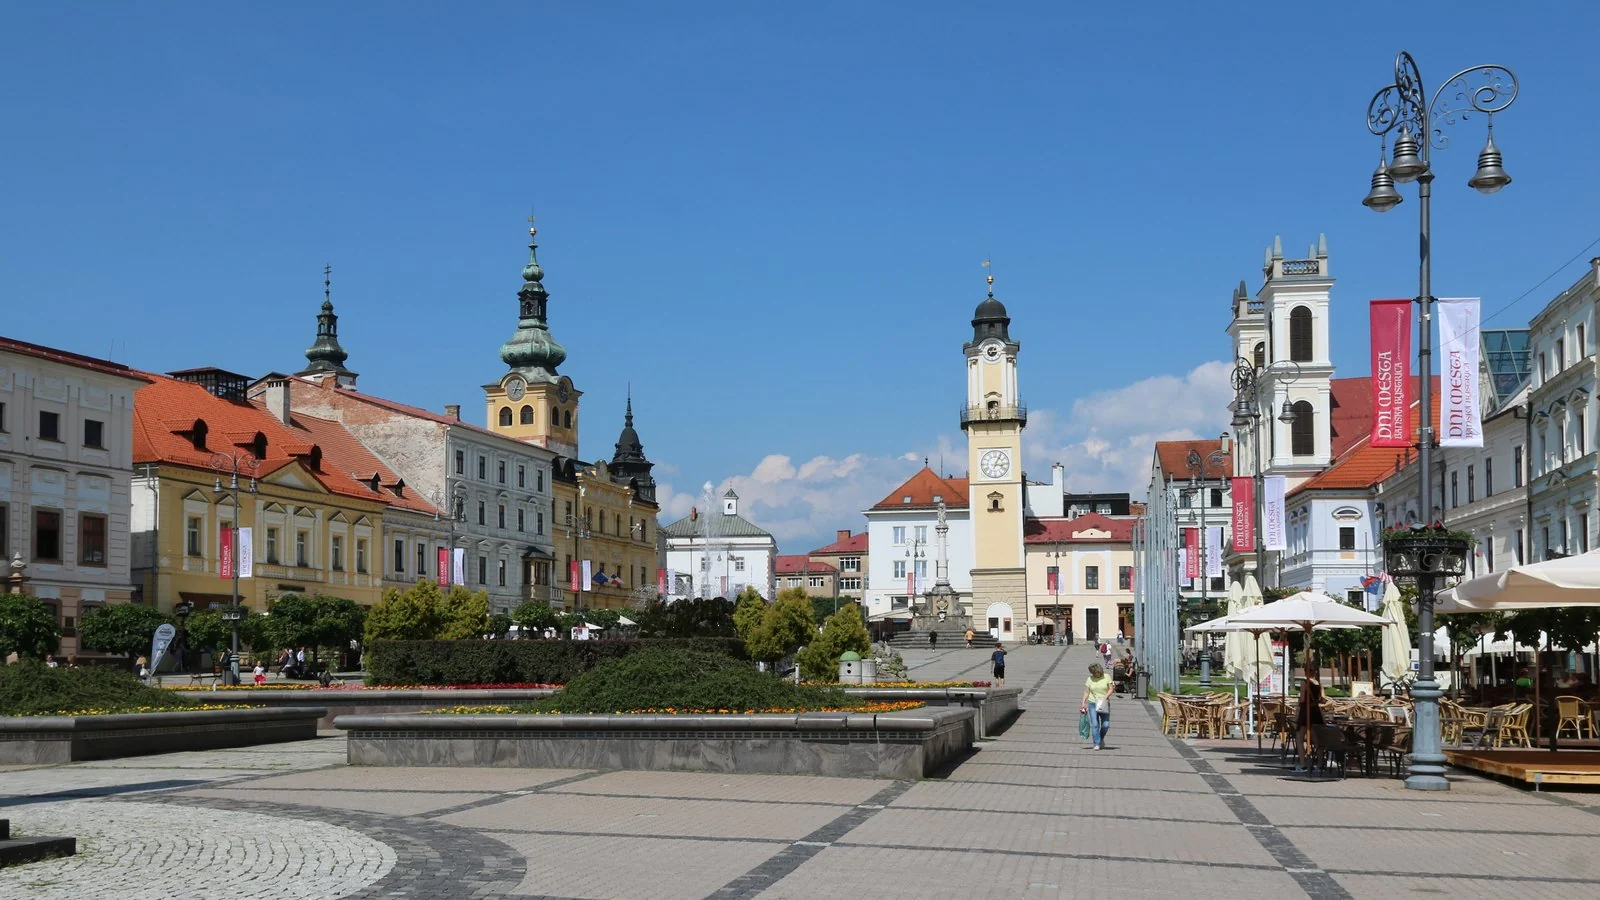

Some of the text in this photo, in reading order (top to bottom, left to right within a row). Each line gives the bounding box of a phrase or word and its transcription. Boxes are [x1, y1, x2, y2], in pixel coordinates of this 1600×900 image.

[1378, 350, 1392, 439] DNI MESTA
[1394, 362, 1404, 405] BYSTRICA
[1449, 350, 1463, 438] DNI MESTA
[1236, 501, 1244, 547] DNI MESTA
